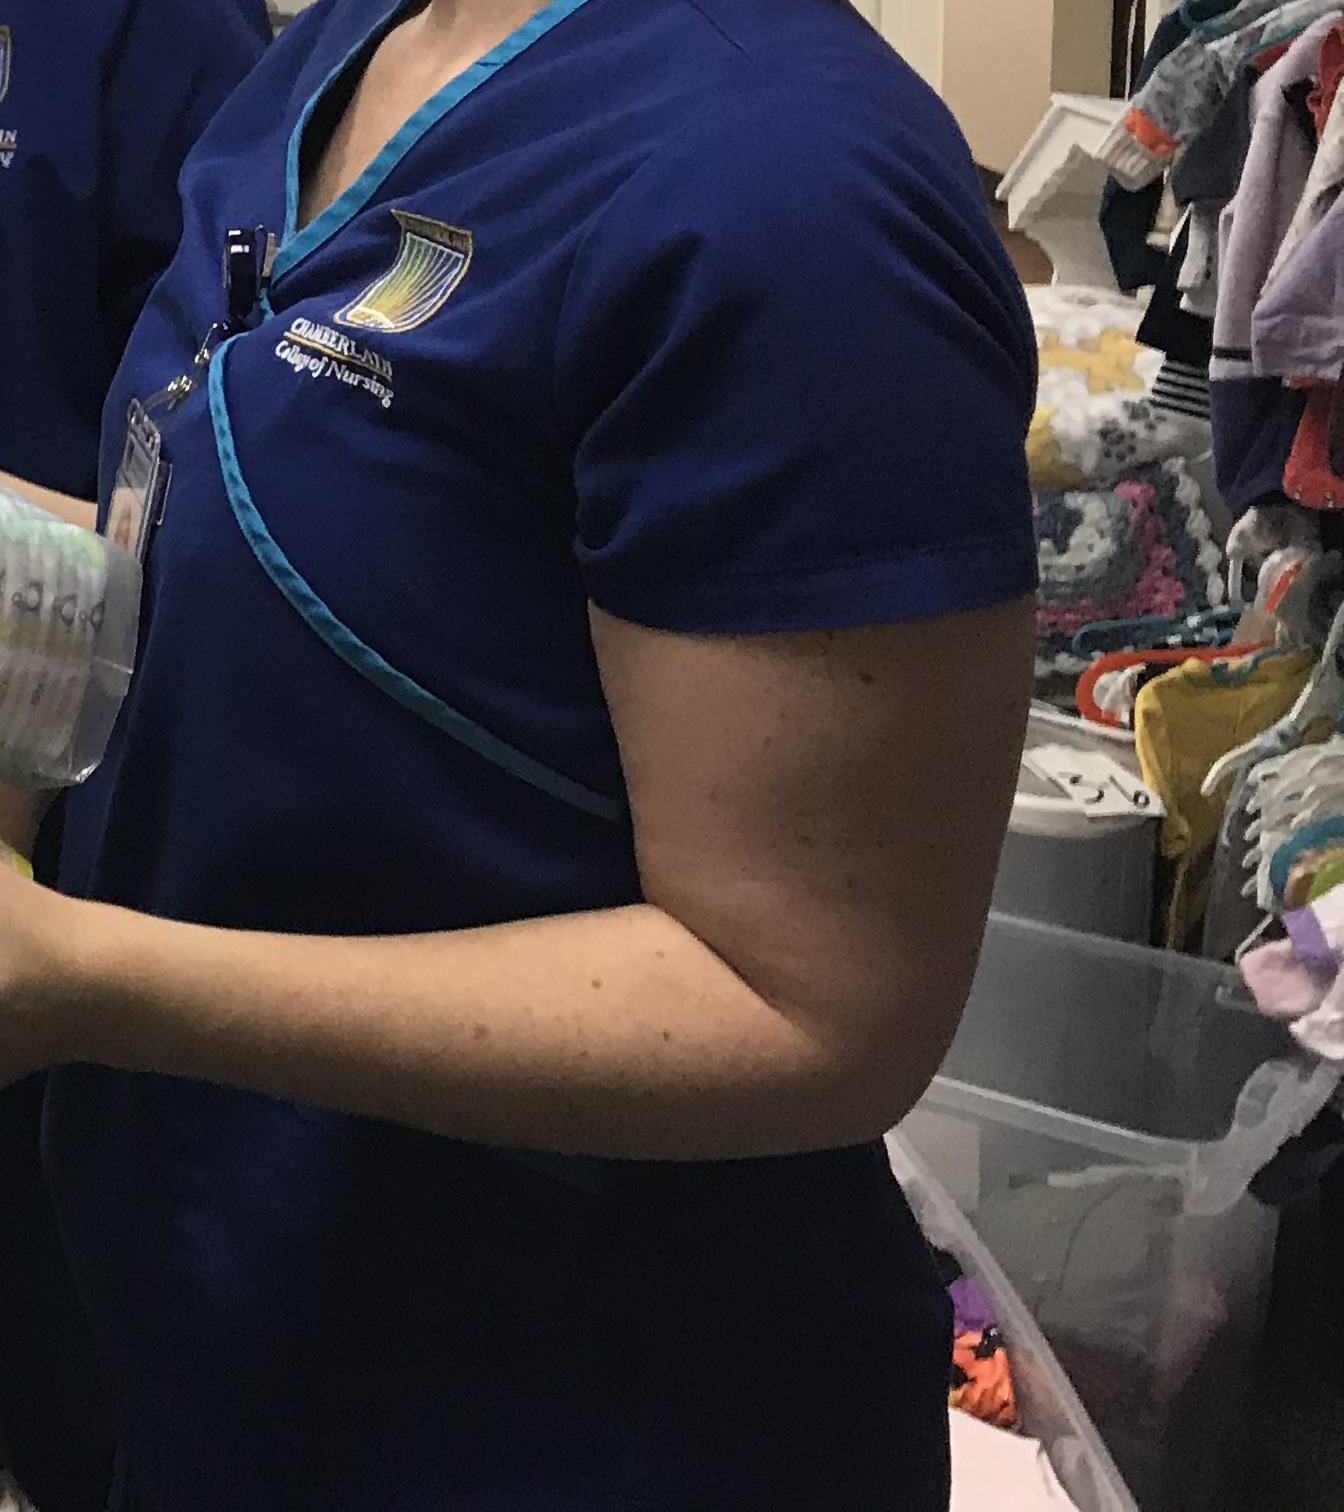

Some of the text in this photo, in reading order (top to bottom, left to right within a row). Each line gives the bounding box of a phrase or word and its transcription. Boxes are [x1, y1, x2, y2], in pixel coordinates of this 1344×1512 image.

[290, 316, 393, 378] CHAMBERLAIN
[310, 356, 329, 378] of
[325, 360, 394, 408] Nursing
